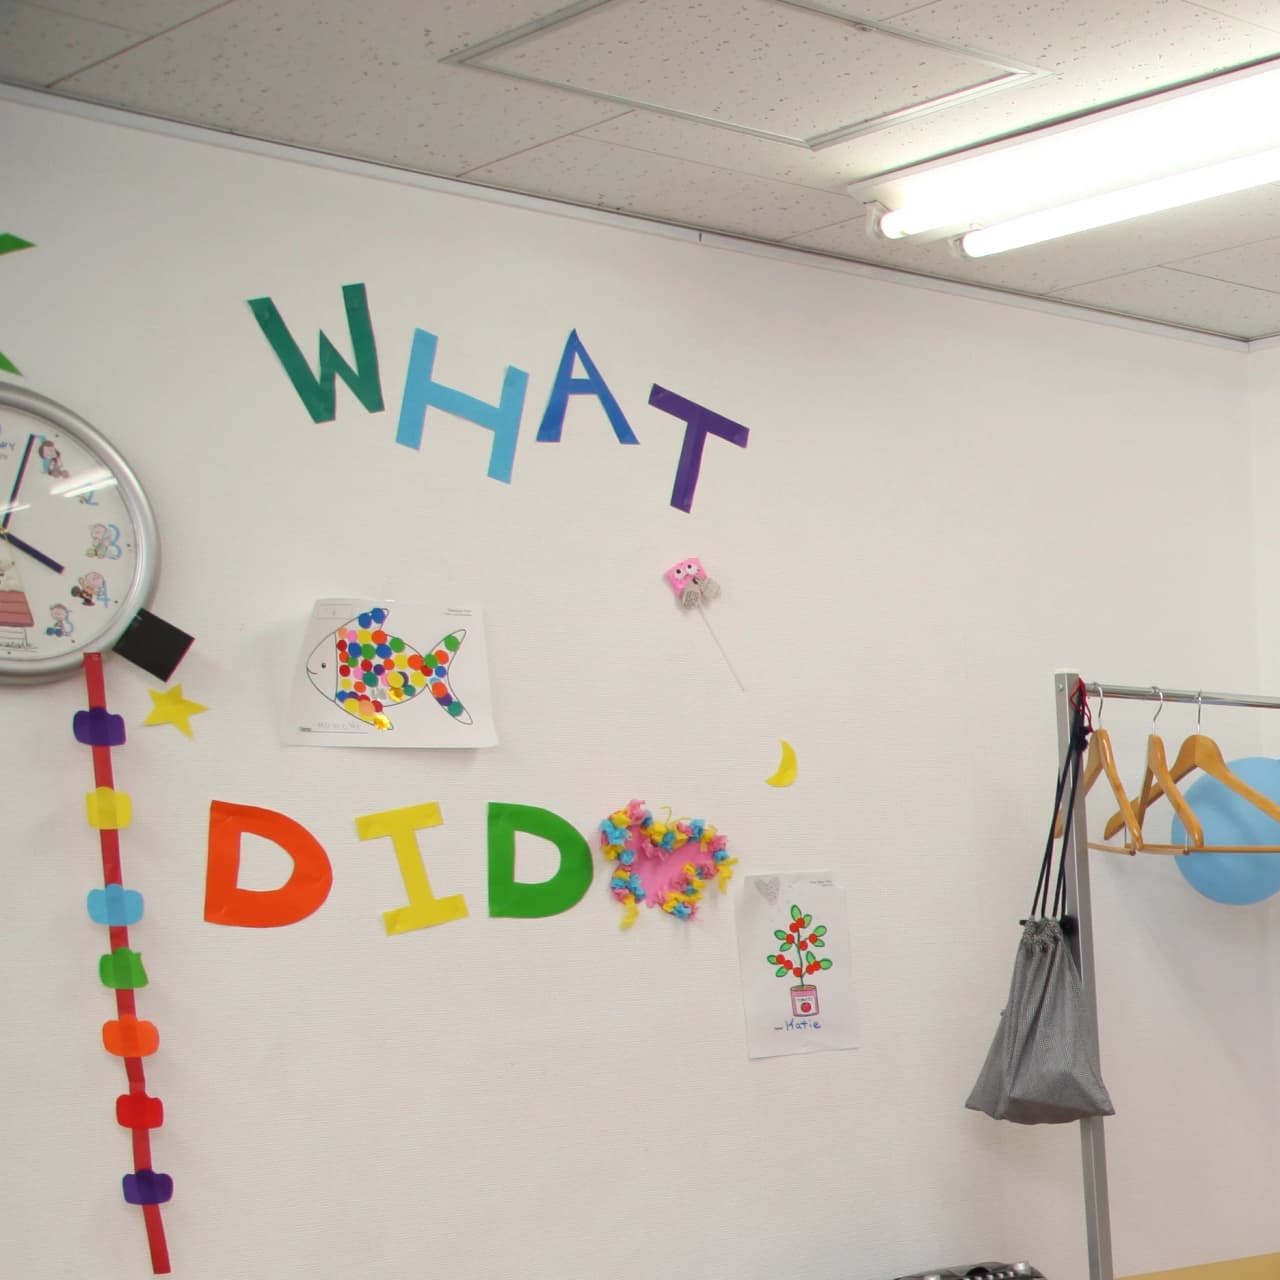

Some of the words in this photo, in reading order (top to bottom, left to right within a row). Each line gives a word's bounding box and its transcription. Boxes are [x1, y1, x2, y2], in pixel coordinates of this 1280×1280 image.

[246, 282, 750, 514] WHAT
[204, 799, 595, 936] DID
[785, 1018, 822, 1031] Katie
